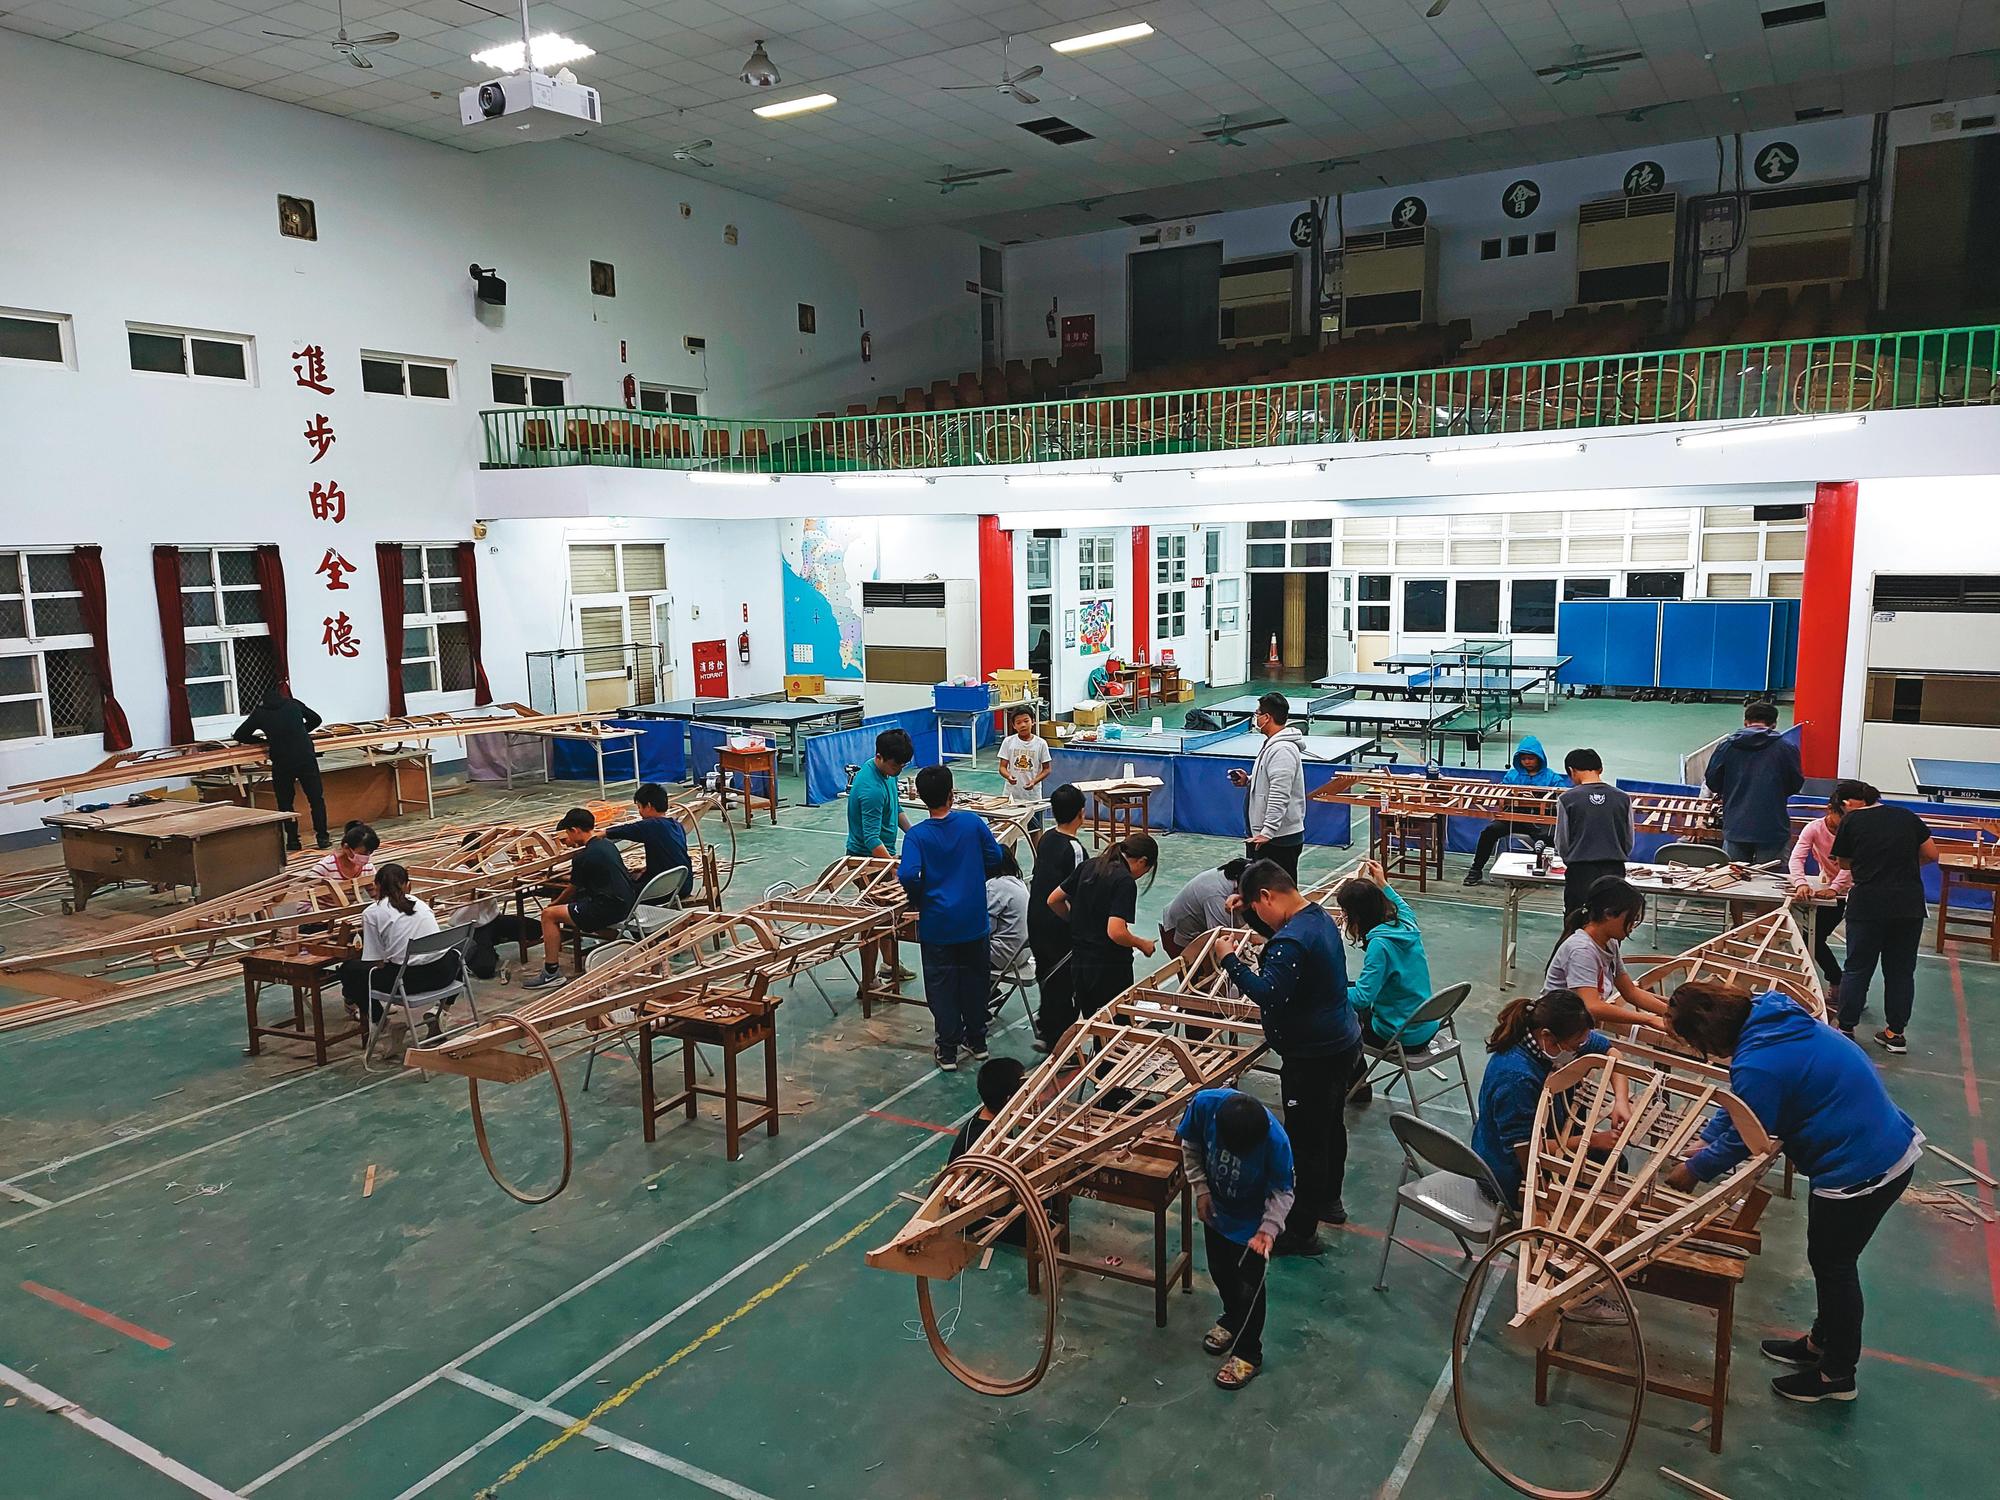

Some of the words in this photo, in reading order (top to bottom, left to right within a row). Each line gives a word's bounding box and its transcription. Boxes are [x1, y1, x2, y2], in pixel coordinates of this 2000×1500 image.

[291, 343, 361, 659] 進步的全德
[699, 660, 725, 672] 消防栓
[700, 671, 724, 680] HYDRANT
[1078, 1186, 1099, 1200] 126
